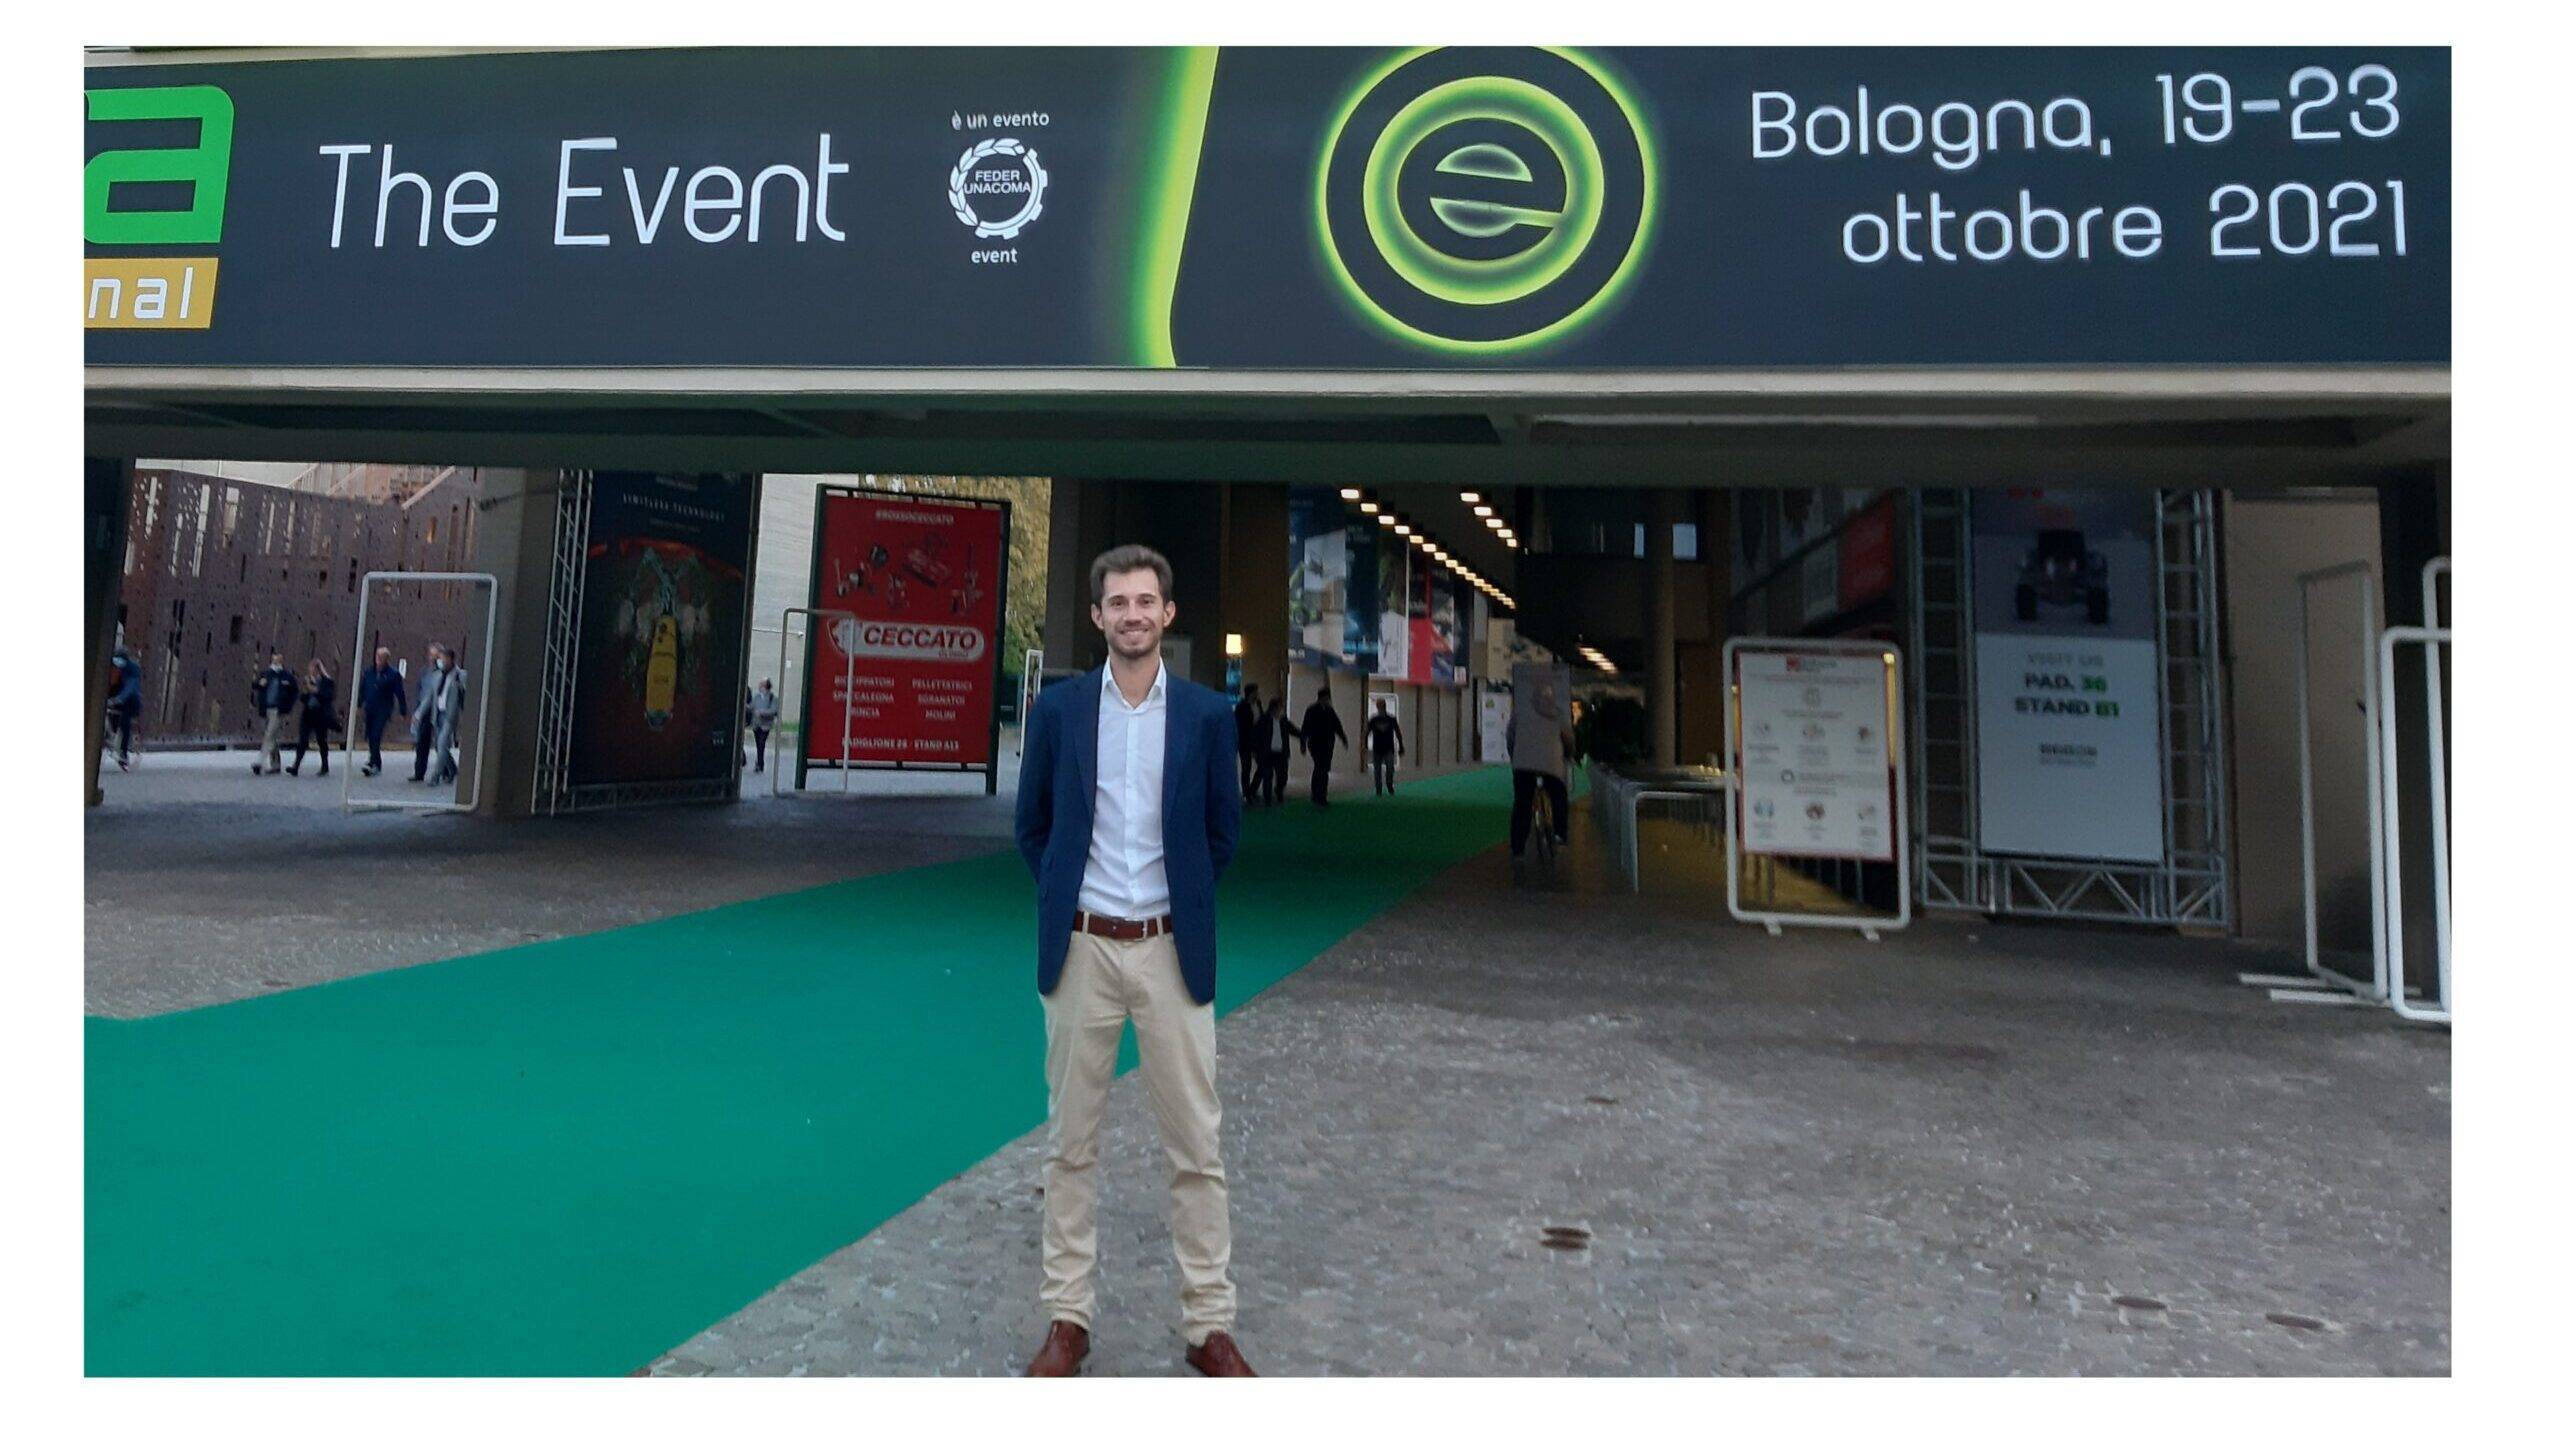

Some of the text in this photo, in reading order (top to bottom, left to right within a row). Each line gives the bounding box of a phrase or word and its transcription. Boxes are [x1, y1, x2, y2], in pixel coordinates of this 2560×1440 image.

[951, 110, 1050, 131] è un evento
[1751, 63, 2401, 171] Bologna, 19-23
[975, 169, 1021, 182] FEDER
[318, 133, 849, 248] The Event
[963, 181, 1032, 194] UNACOMA
[1842, 180, 2408, 263] ottobre 2021
[970, 247, 1018, 264] event
[864, 624, 977, 650] CECCATO
[2024, 672, 2075, 690] PAD.
[2014, 696, 2090, 713] STAND
